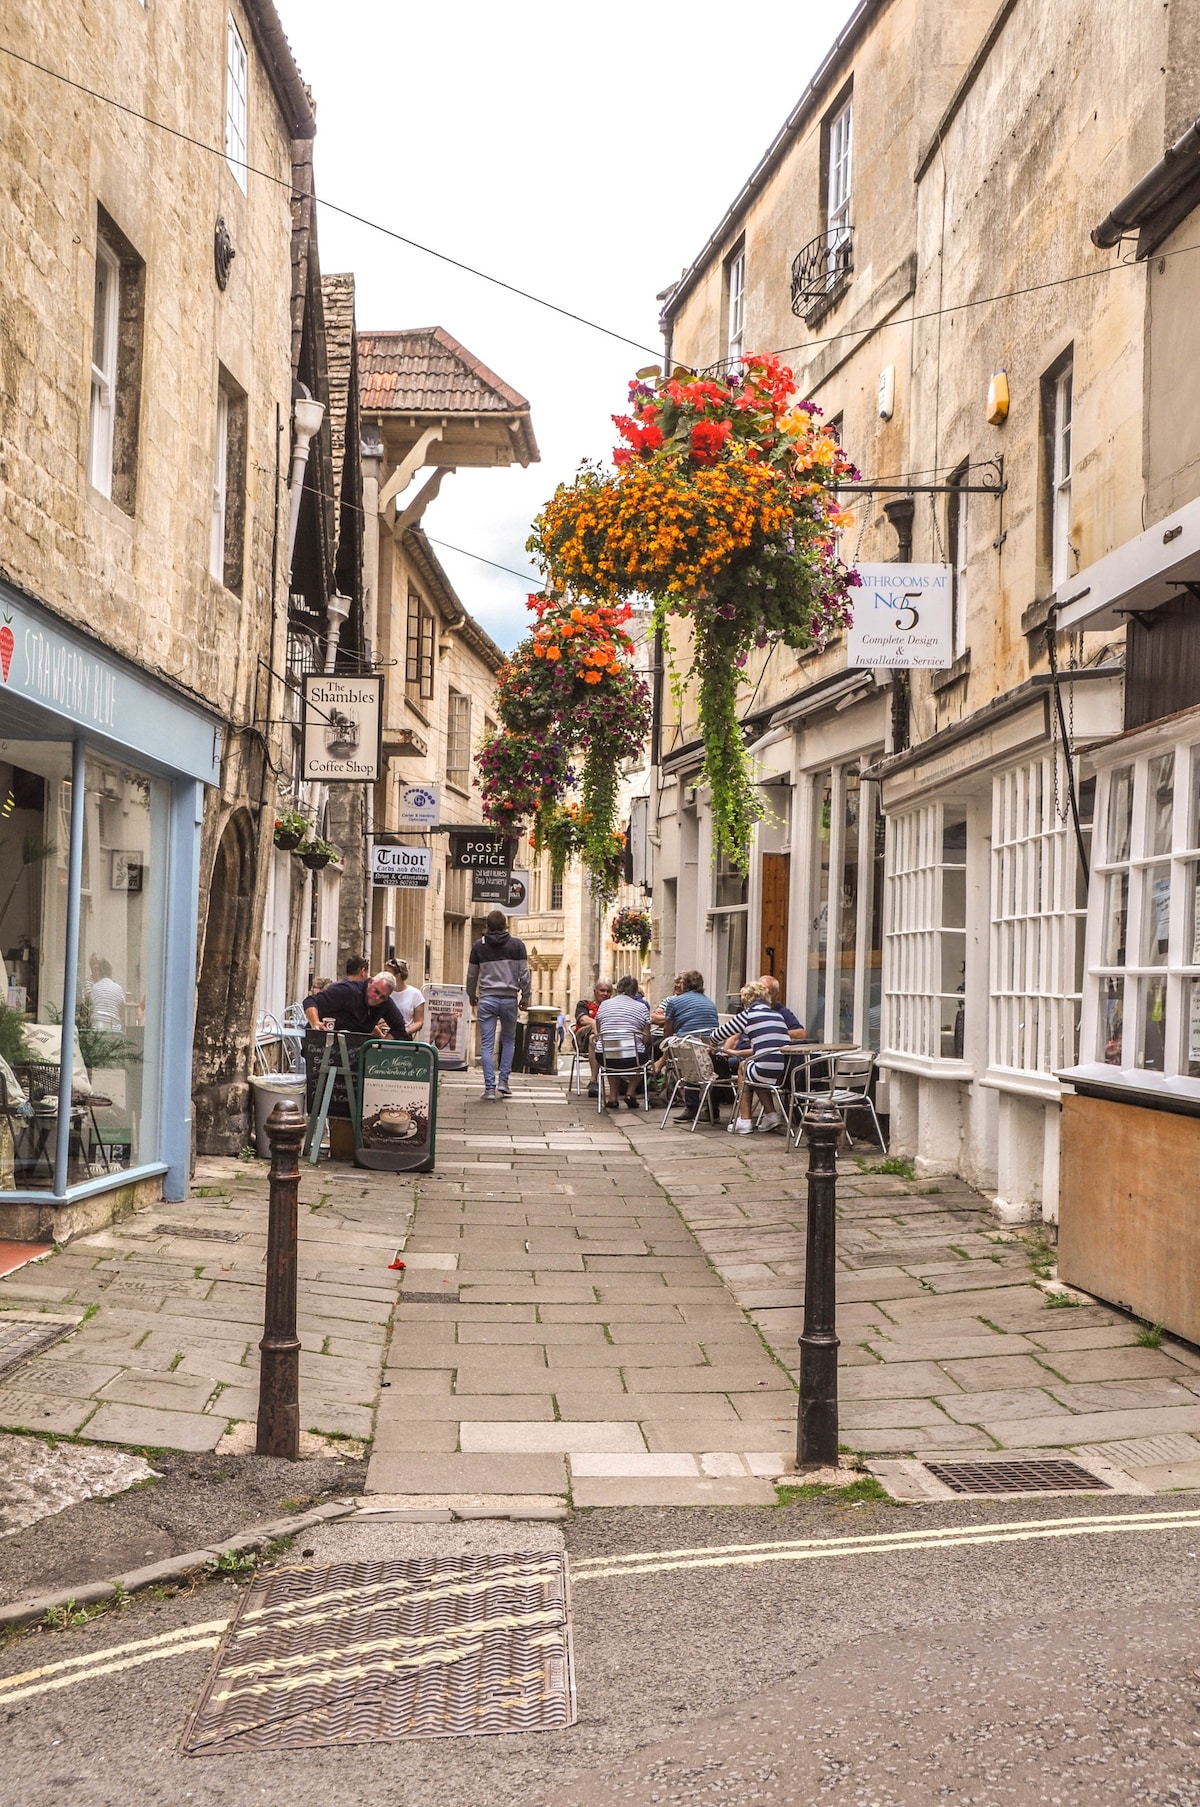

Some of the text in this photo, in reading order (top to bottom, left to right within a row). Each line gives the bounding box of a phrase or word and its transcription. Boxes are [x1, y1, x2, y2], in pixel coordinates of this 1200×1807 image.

[861, 575, 948, 588] ATHROOMS AT
[895, 591, 923, 631] 5
[862, 634, 939, 648] Complete Design
[896, 646, 904, 656] &
[855, 655, 945, 666] Installation Service
[24, 628, 117, 727] STRAWBERRY BLUE
[326, 682, 345, 692] The
[311, 687, 375, 704] Shambles
[309, 759, 374, 776] Coffee Shop
[466, 842, 500, 853] POST
[377, 849, 427, 866] Tudor
[460, 854, 506, 866] OFFICE
[475, 877, 507, 887] Day Nursery
